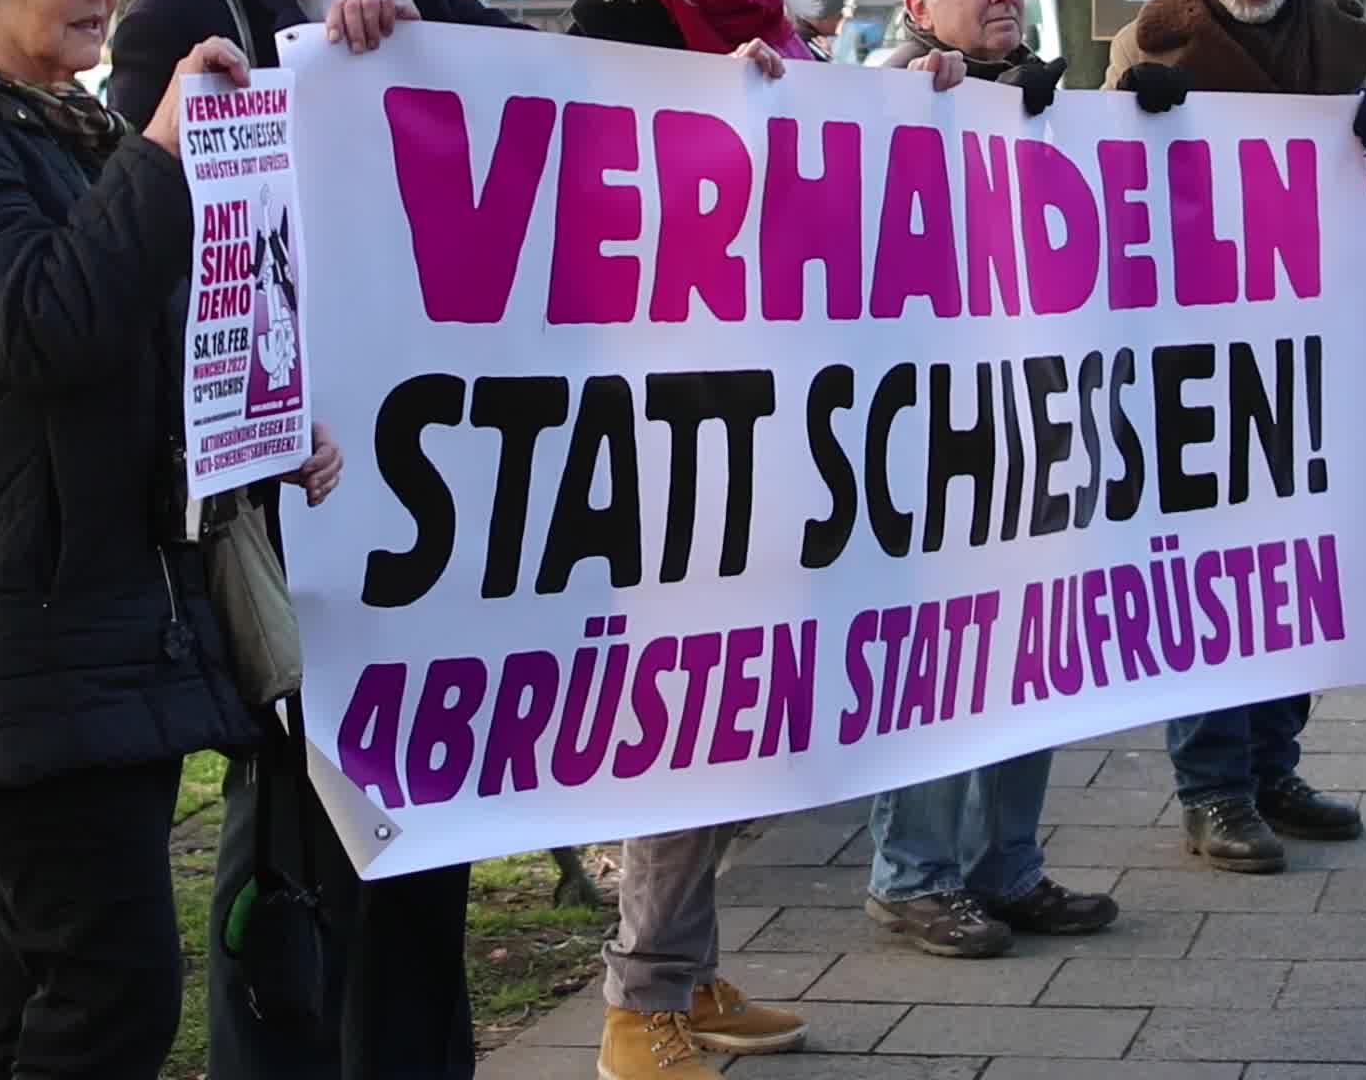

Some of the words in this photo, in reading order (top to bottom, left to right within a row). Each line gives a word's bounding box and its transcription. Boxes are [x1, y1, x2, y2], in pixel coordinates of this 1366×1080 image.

[186, 88, 287, 122] VERHANDELN
[187, 127, 227, 155] STATT
[202, 199, 249, 243] ANTI
[384, 86, 1321, 325] VERHANDELN
[201, 241, 251, 286] SIKO
[197, 283, 251, 322] DEMO
[361, 370, 775, 608] STATT
[800, 336, 1328, 569] SCHIESSEN!
[337, 616, 817, 809] ABRÜSTEN
[839, 591, 999, 745] STATT
[1012, 535, 1345, 705] AUFRÜSTEN
